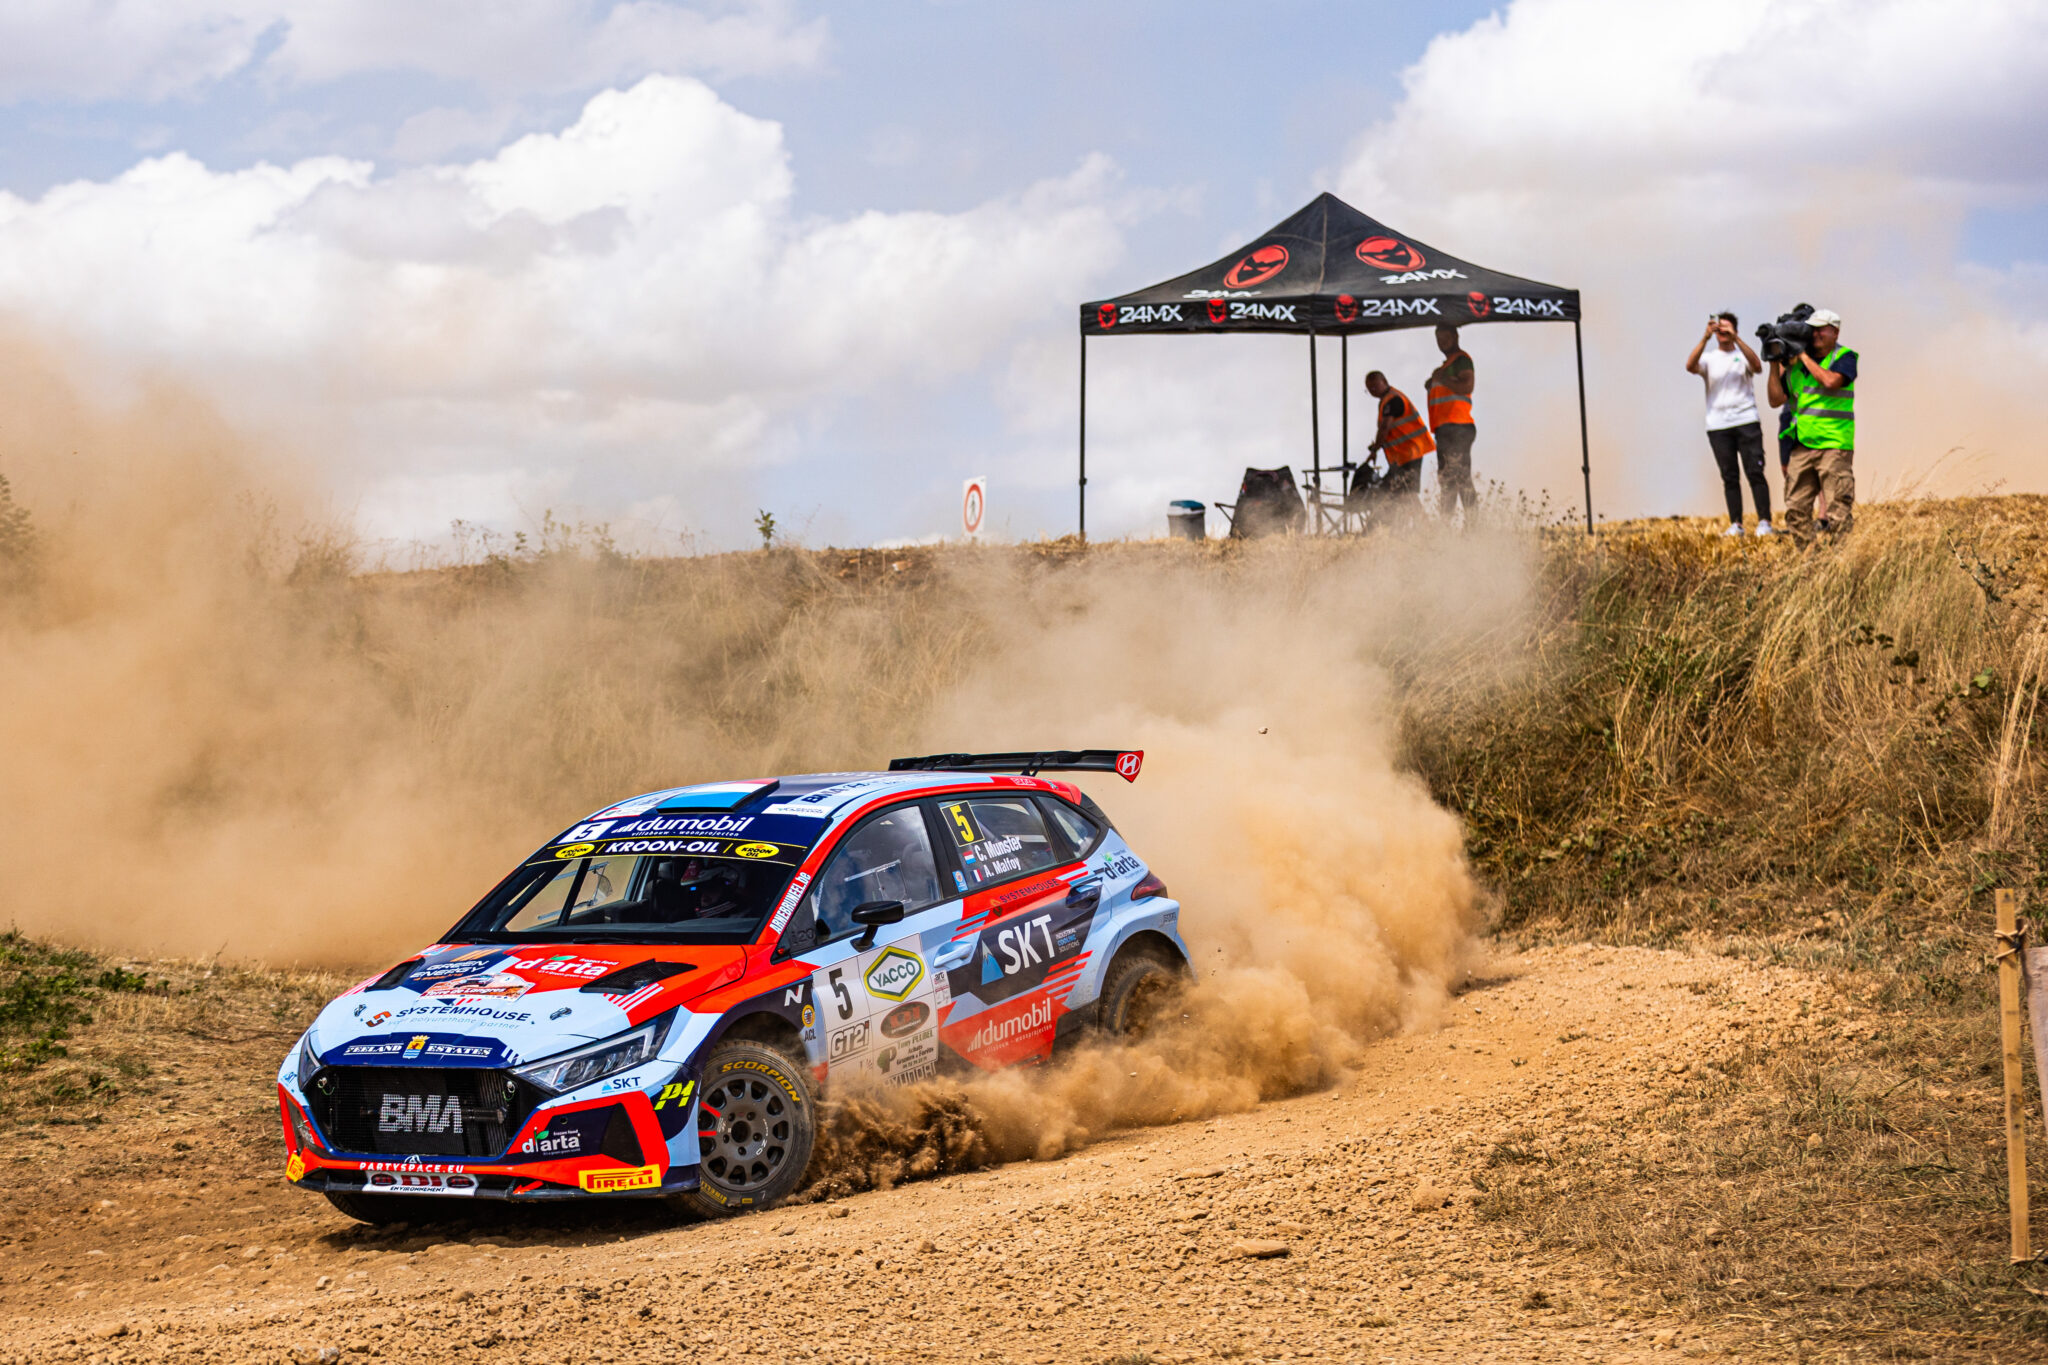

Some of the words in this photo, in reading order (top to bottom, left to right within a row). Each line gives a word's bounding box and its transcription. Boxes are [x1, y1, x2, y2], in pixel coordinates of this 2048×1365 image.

[1380, 269, 1468, 285] 24MX
[1119, 304, 1184, 324] 24MX
[1229, 302, 1297, 322] 24MX
[1362, 298, 1443, 317] 24MX
[1493, 297, 1566, 316] 24MX
[574, 823, 602, 840] 5
[636, 816, 755, 832] dumobil
[950, 805, 975, 842] 5
[605, 841, 720, 853] KROON-OIL
[974, 844, 988, 862] C.
[984, 836, 1023, 859] Munster
[984, 864, 995, 878] A.
[992, 857, 1021, 875] Malfoy
[1000, 879, 1060, 903] SYSTEMHOUSE
[998, 914, 1055, 975] SKT
[873, 962, 916, 987] YACCO
[828, 967, 853, 1020] 5
[396, 1006, 531, 1022] SYSTEMHOUSE
[982, 997, 1052, 1046] dumobil
[804, 1028, 817, 1042] ACL
[830, 1020, 870, 1059] GT2i
[427, 1046, 490, 1055] ESTATES
[613, 1077, 640, 1089] SKT
[722, 1061, 800, 1102] SCORPION
[379, 1094, 462, 1133] BMA
[359, 1162, 465, 1173] PARTYSPACE.EU
[587, 1170, 653, 1189] PIRELLI
